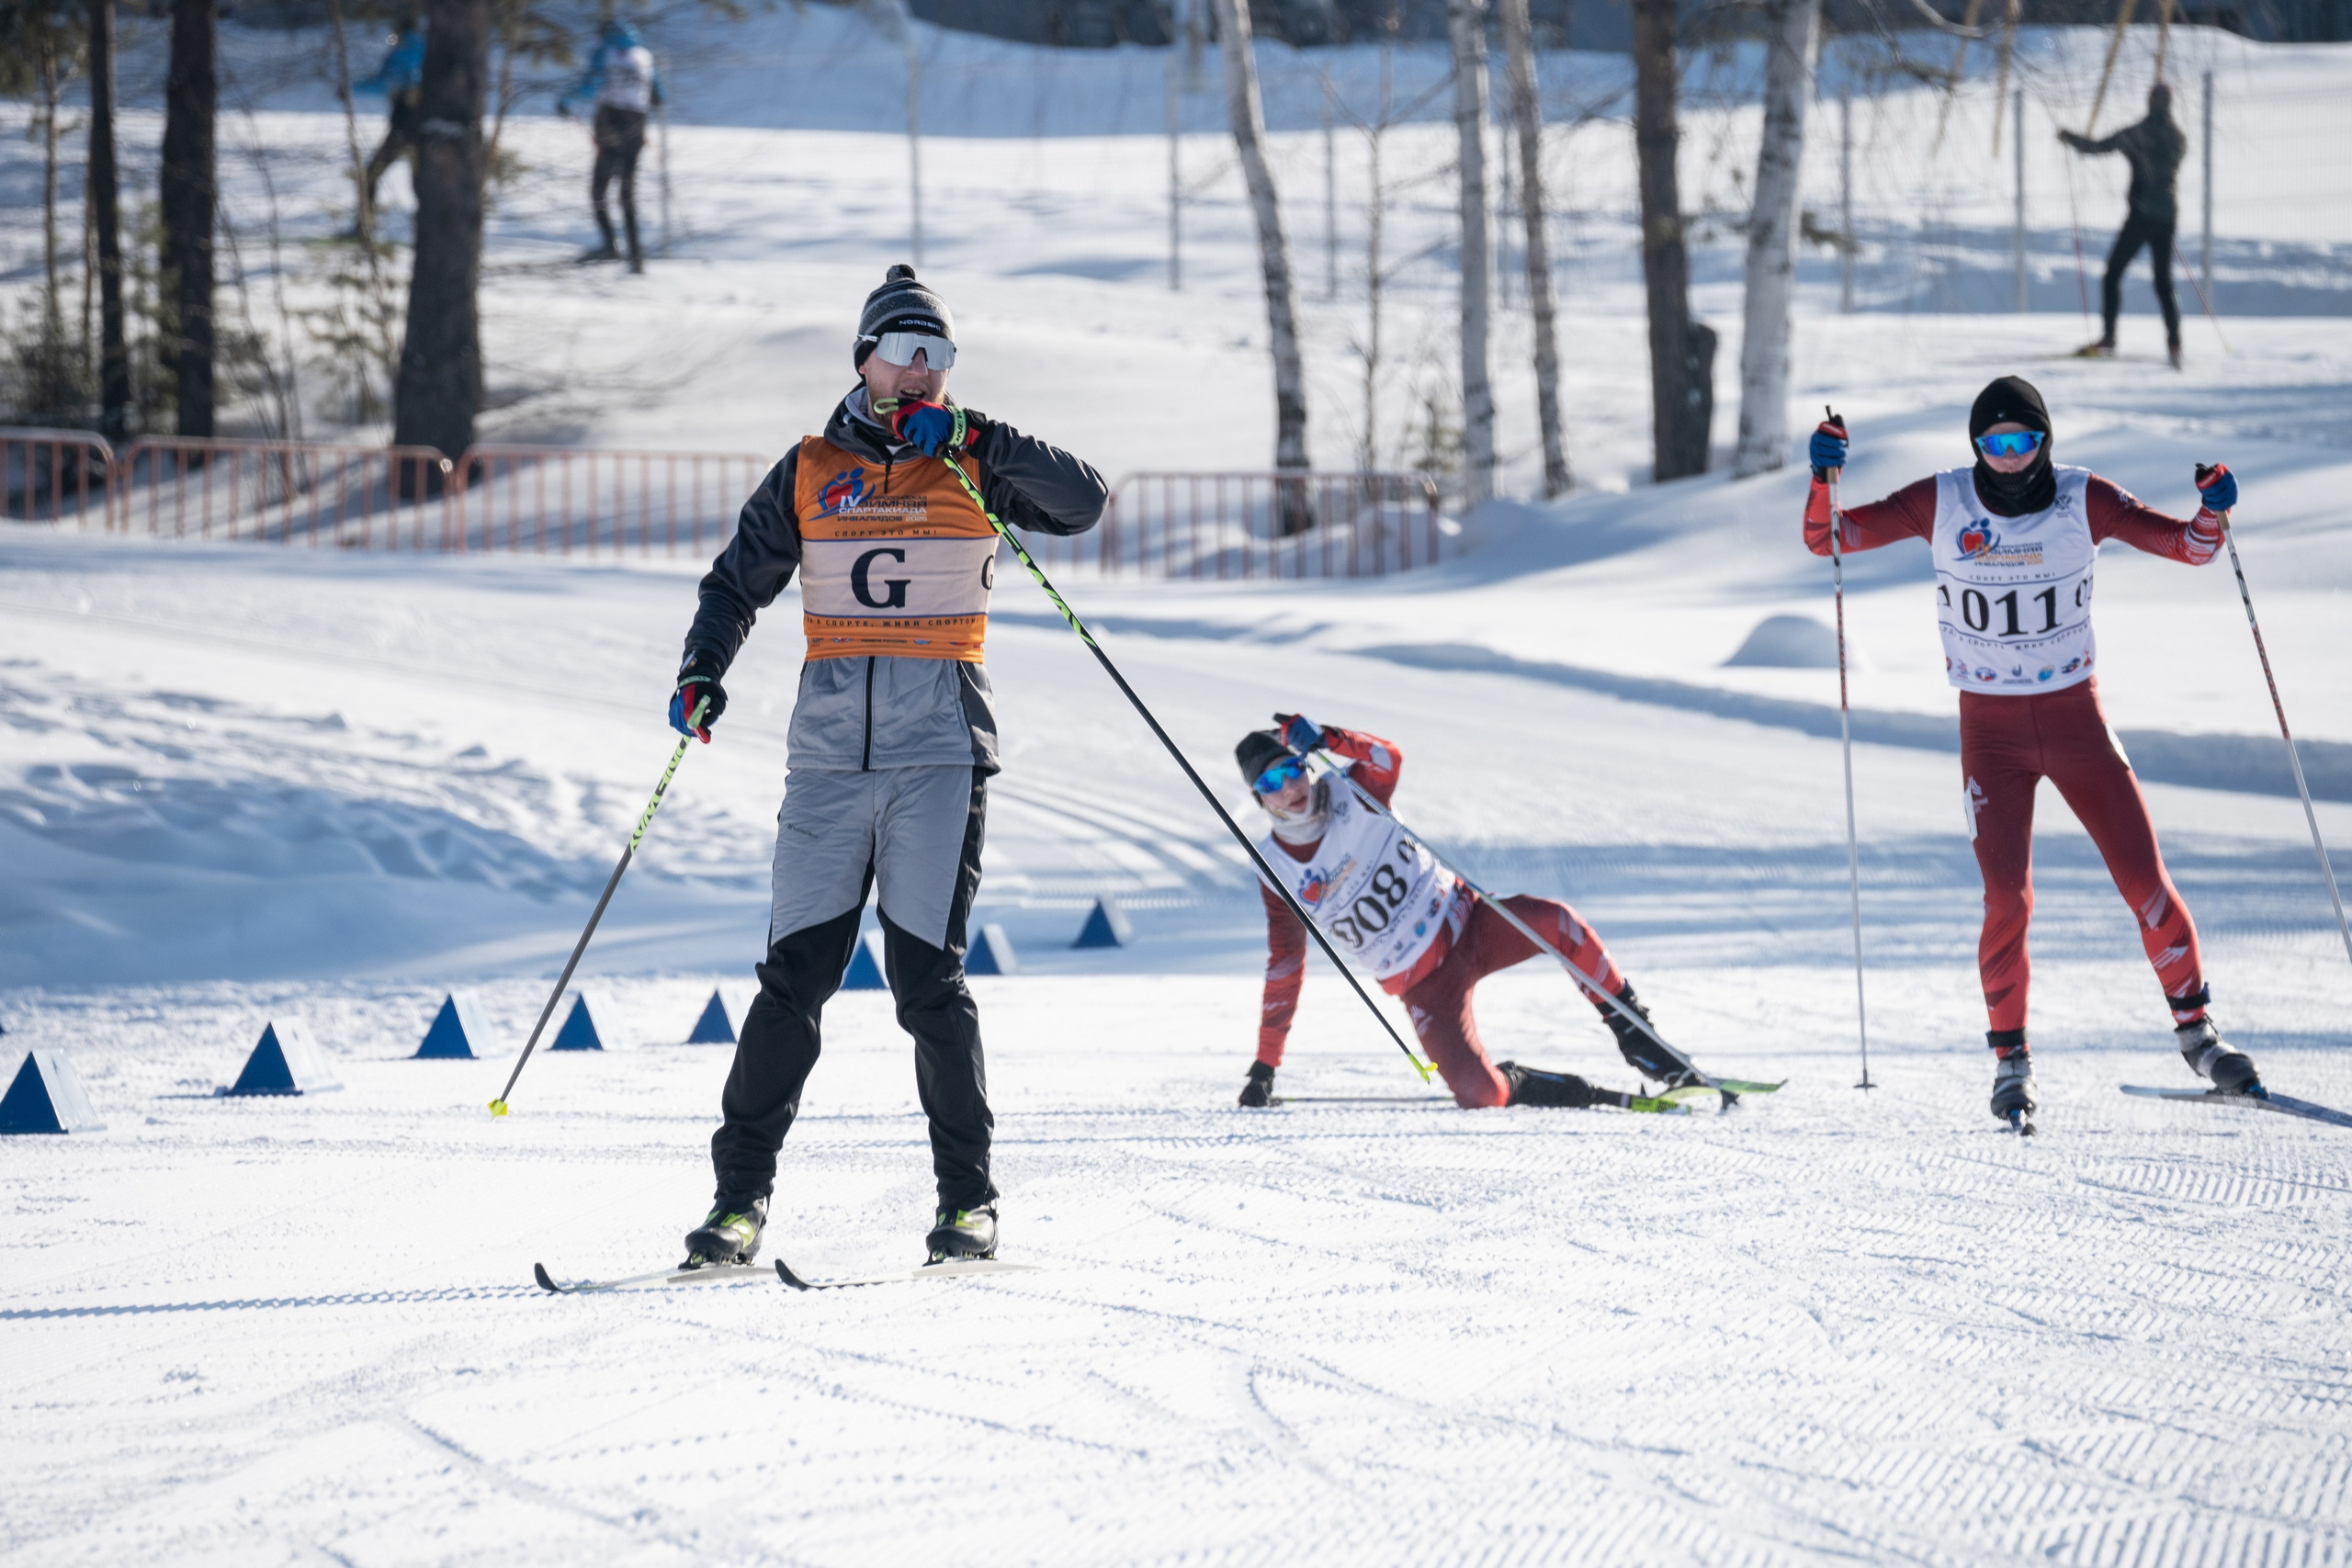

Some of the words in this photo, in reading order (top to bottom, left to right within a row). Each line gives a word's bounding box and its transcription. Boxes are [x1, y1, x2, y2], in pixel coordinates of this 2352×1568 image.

[899, 319, 941, 331] NORDSKI
[840, 495, 862, 507] IV
[838, 506, 927, 514] СПАРТАКИАДА
[850, 547, 911, 609] G
[1962, 585, 2064, 637] 011
